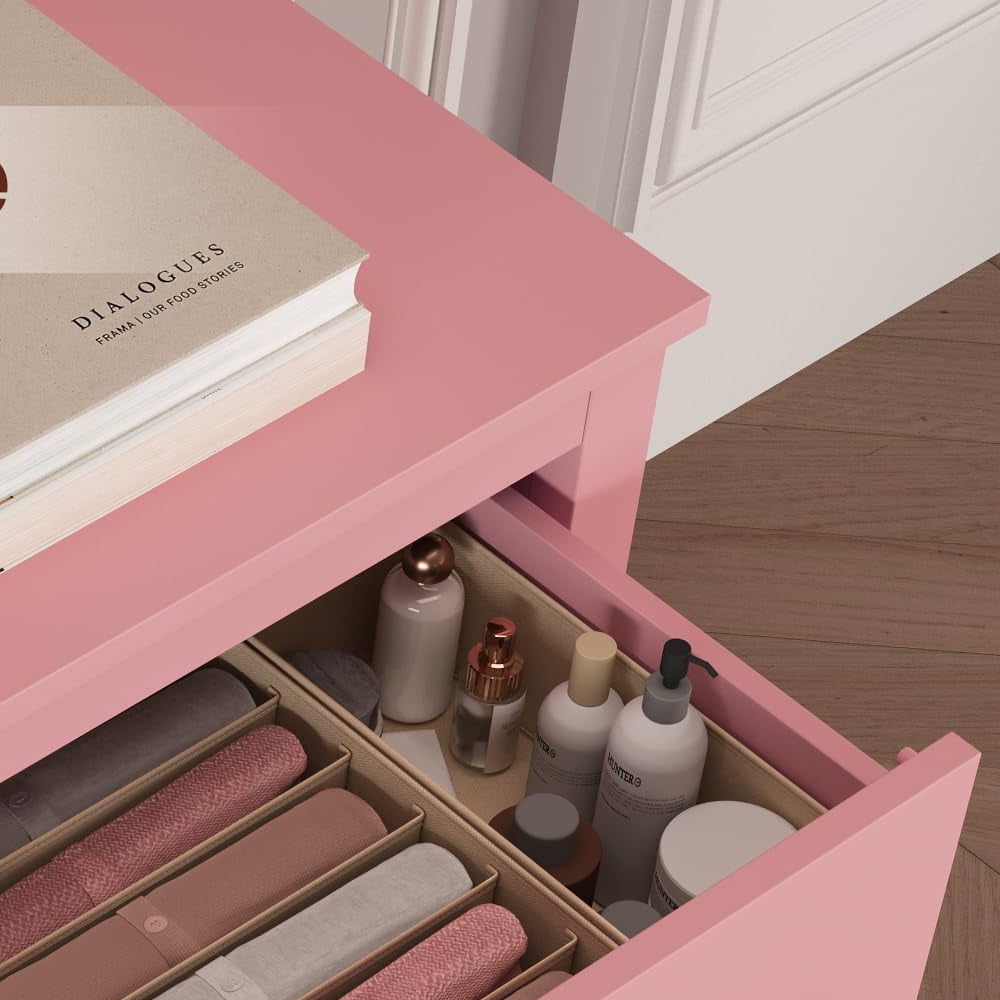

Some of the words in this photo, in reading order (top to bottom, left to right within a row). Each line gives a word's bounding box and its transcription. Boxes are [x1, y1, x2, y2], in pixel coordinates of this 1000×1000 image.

[70, 242, 225, 331] DIALOGUES
[95, 320, 137, 345] FRAMA
[142, 304, 167, 320] OUR
[166, 287, 197, 306] FOOD
[197, 261, 245, 289] STORIES
[608, 751, 634, 786] HUNTER
